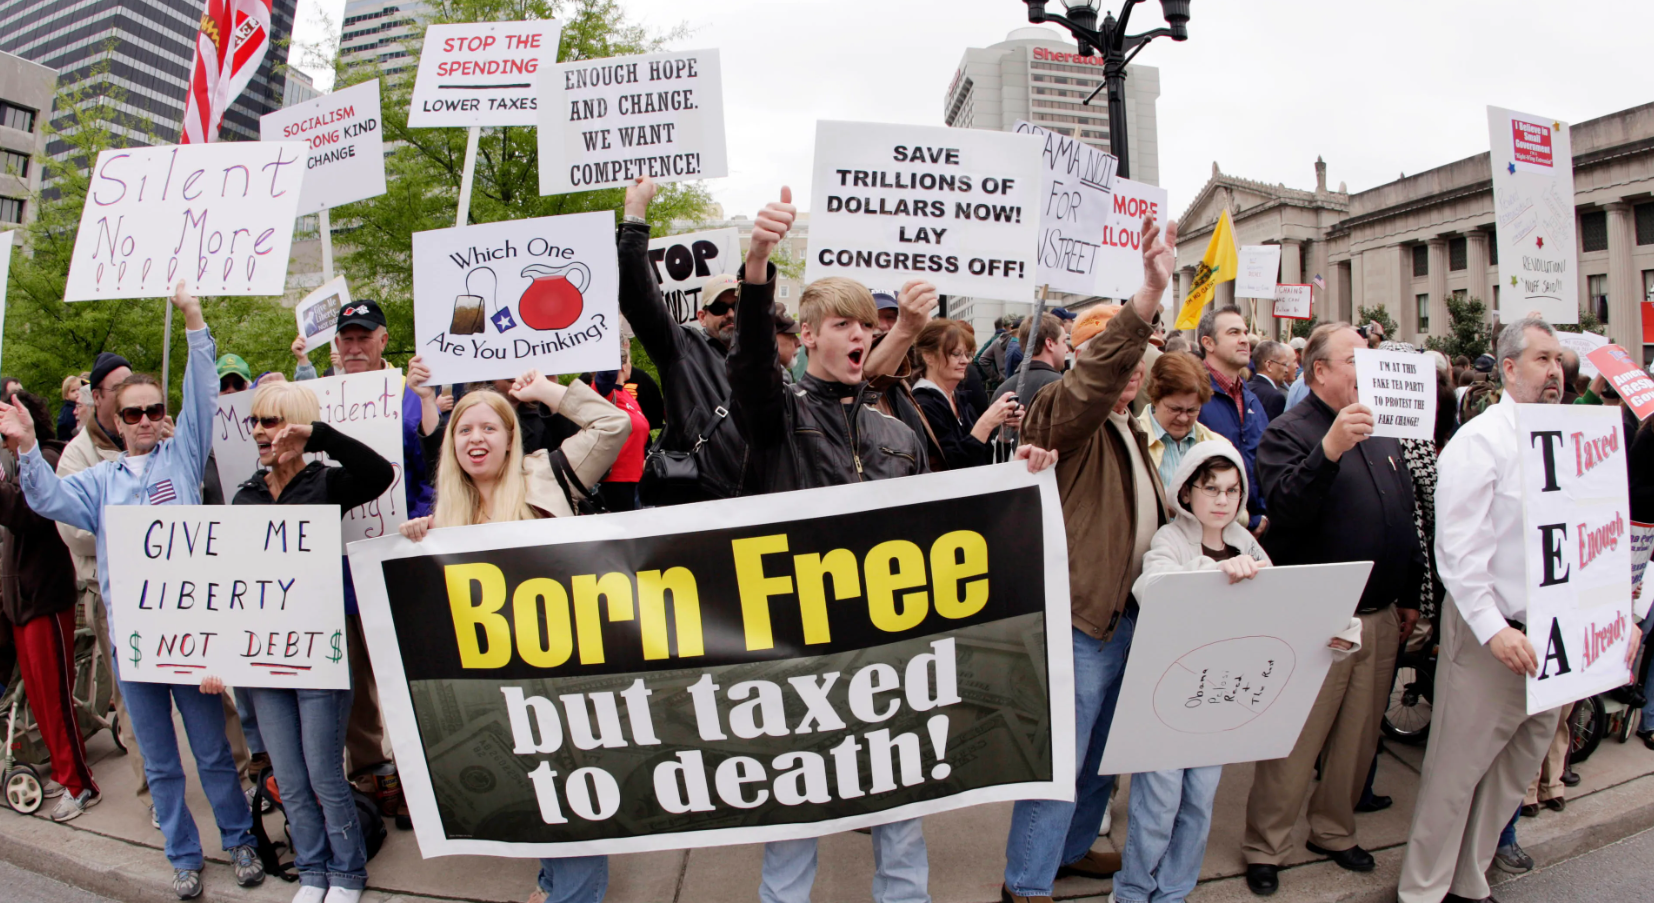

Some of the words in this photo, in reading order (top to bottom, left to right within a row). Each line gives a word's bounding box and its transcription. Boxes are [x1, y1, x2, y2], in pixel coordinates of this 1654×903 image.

[443, 36, 496, 53] STOP
[505, 33, 542, 49] THE
[437, 58, 539, 77] SPENDING
[564, 63, 639, 90] ENOUGH
[649, 58, 698, 81] HOPE
[423, 98, 480, 113] LOWER
[487, 97, 538, 111] TAXES
[569, 97, 608, 121] AND
[618, 89, 699, 116] CHANGE.
[283, 105, 355, 138] SOCIALISM
[303, 130, 340, 150] RONG
[344, 118, 377, 139] KIND
[582, 129, 611, 152] WE
[618, 123, 675, 148] WANT
[307, 145, 356, 169] CHANGE
[893, 145, 961, 166] SAVE
[1515, 139, 1551, 154] Government
[93, 147, 298, 206] Silent
[570, 153, 702, 187] COMPETENCE!
[835, 169, 973, 193] TRILLIONS
[981, 178, 1015, 196] OF
[1083, 149, 1119, 190] NOT
[827, 196, 945, 218] DOLLARS
[954, 202, 1022, 224] NOW!
[1046, 180, 1082, 224] FOR
[1113, 193, 1158, 221] MORE
[92, 215, 135, 266] No
[174, 208, 275, 275] More
[899, 226, 947, 245] LAY
[1102, 225, 1141, 250] ILOU
[449, 239, 517, 270] Which
[526, 237, 575, 260] One
[648, 240, 719, 284] TOP
[818, 249, 960, 274] CONGRESS
[968, 258, 1025, 278] OFF!
[1522, 255, 1566, 274] REVOLUTION!
[426, 331, 465, 357] Are
[472, 338, 507, 360] You
[513, 313, 608, 359] Drinking?
[1379, 361, 1391, 372] I'M
[1392, 362, 1400, 373] AT
[1402, 363, 1417, 375] THIS
[320, 377, 399, 424] ident,
[1372, 378, 1390, 389] FAKE
[1391, 379, 1403, 390] TEA
[1404, 380, 1424, 393] PARTY
[1374, 395, 1384, 406] TO
[1385, 397, 1412, 409] PROTEST
[1414, 399, 1425, 410] THE
[1378, 414, 1394, 426] FAKE
[1395, 415, 1419, 427] CHANGE!
[1570, 425, 1619, 478] Taxed
[143, 520, 219, 560] GIVE
[264, 520, 311, 554] ME
[1576, 511, 1624, 570] Enough
[138, 578, 296, 611] LIBERTY
[444, 562, 704, 669] Born
[732, 529, 990, 652] Free
[156, 632, 218, 658] NOT
[1580, 610, 1629, 673] Already
[500, 676, 661, 756] but
[687, 637, 962, 742] taxed
[1185, 668, 1209, 708] Obama
[528, 759, 621, 825] to
[654, 714, 952, 815] death!
